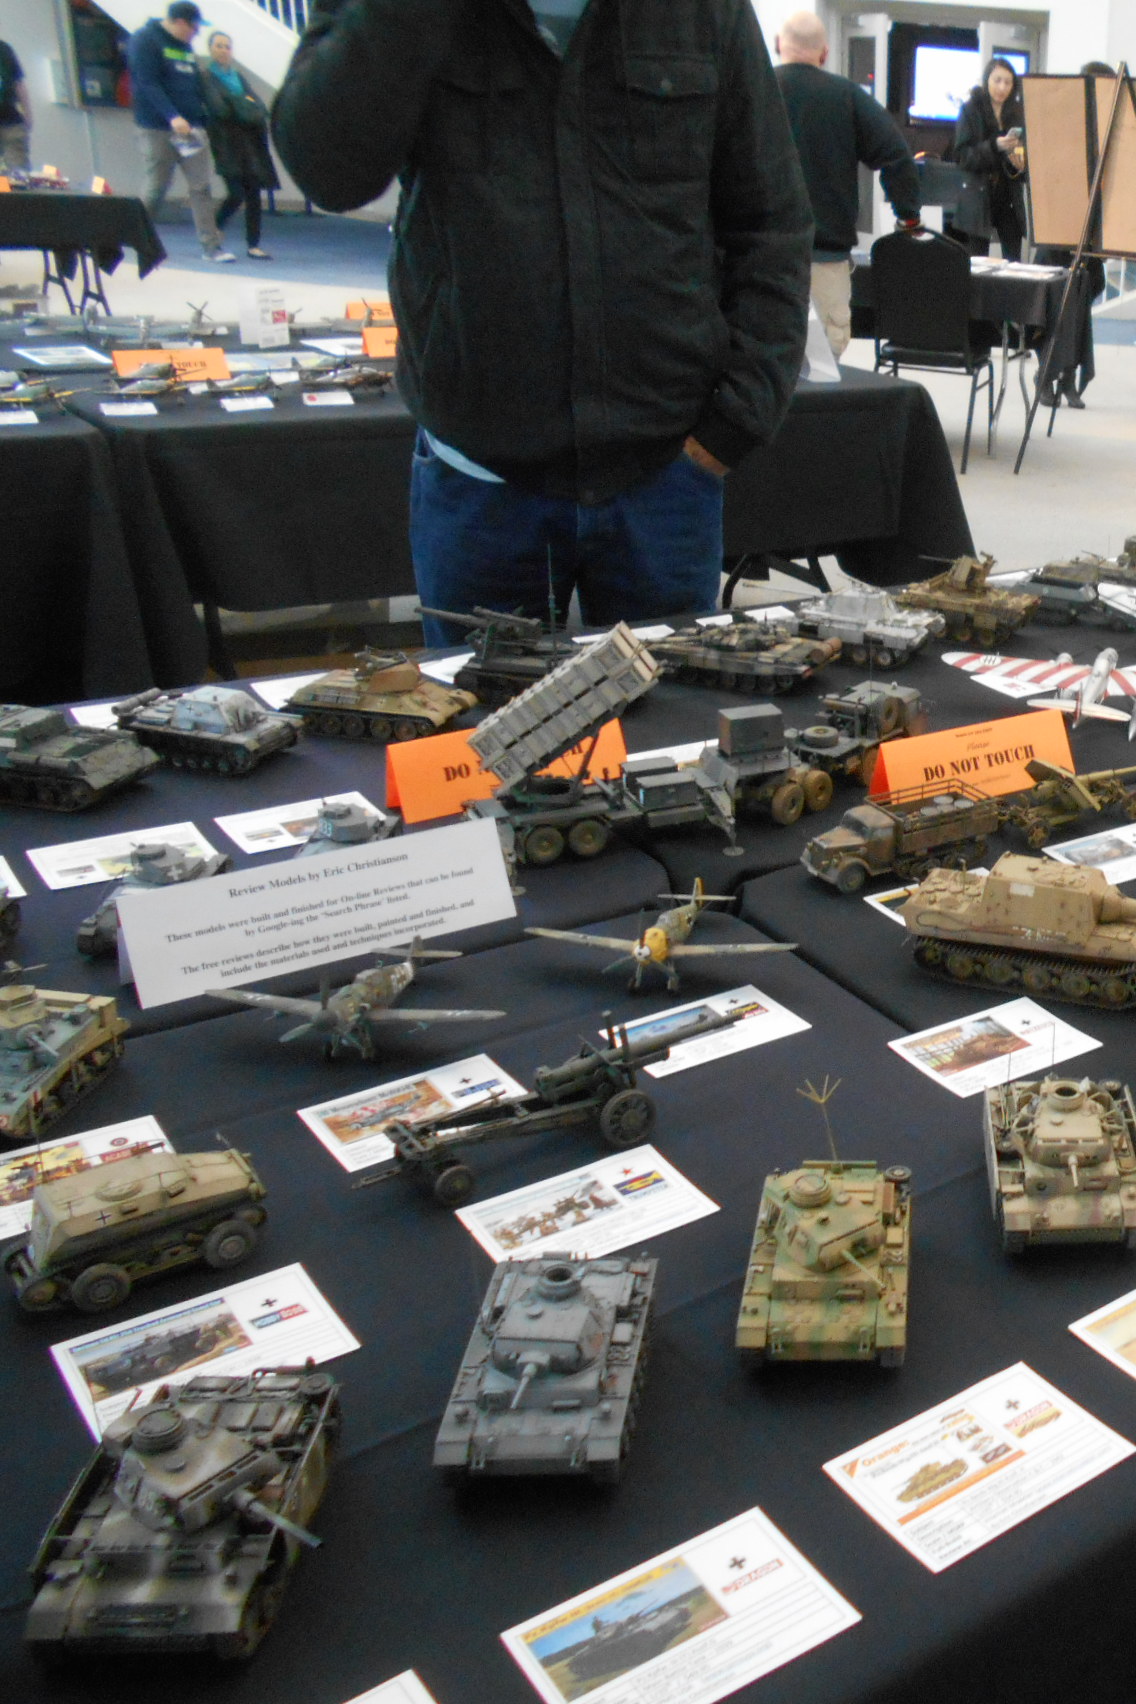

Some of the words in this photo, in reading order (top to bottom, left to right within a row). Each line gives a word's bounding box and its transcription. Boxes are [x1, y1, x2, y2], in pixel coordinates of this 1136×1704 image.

[442, 763, 470, 782] DO
[923, 764, 946, 782] DO
[949, 756, 981, 776] NOT
[984, 744, 1036, 767] TOUCH
[229, 886, 265, 898] Review
[269, 875, 306, 889] Models
[309, 872, 320, 882] by
[323, 866, 344, 878] Eric
[347, 853, 408, 873] Christianson
[166, 932, 192, 943] These
[195, 925, 226, 937] models
[228, 919, 249, 928] were
[251, 913, 271, 924] built
[273, 908, 289, 919] and
[291, 902, 324, 915] finished
[326, 899, 338, 907] for
[340, 891, 371, 903] On-line
[373, 884, 406, 896] Reviews
[407, 879, 423, 889] that
[425, 876, 439, 885] can
[440, 873, 450, 881] be
[451, 867, 474, 879] found
[258, 918, 304, 934] Google-ing
[306, 912, 319, 923] the
[386, 893, 411, 904] listed.
[181, 965, 200, 975] The
[201, 961, 219, 971] free
[221, 953, 254, 966] reviews
[256, 943, 292, 957] describe
[293, 938, 310, 949] how
[312, 933, 330, 945] they
[332, 930, 353, 938] were
[354, 923, 376, 934] built,
[378, 916, 408, 930] painted
[409, 911, 424, 921] and
[425, 904, 458, 917] finished,
[460, 899, 475, 909] and
[220, 964, 252, 977] include
[254, 960, 268, 970] the
[270, 951, 310, 966] materials
[311, 945, 330, 955] used
[332, 941, 348, 951] and
[350, 930, 392, 947] techniques
[394, 917, 446, 936] incorporated.
